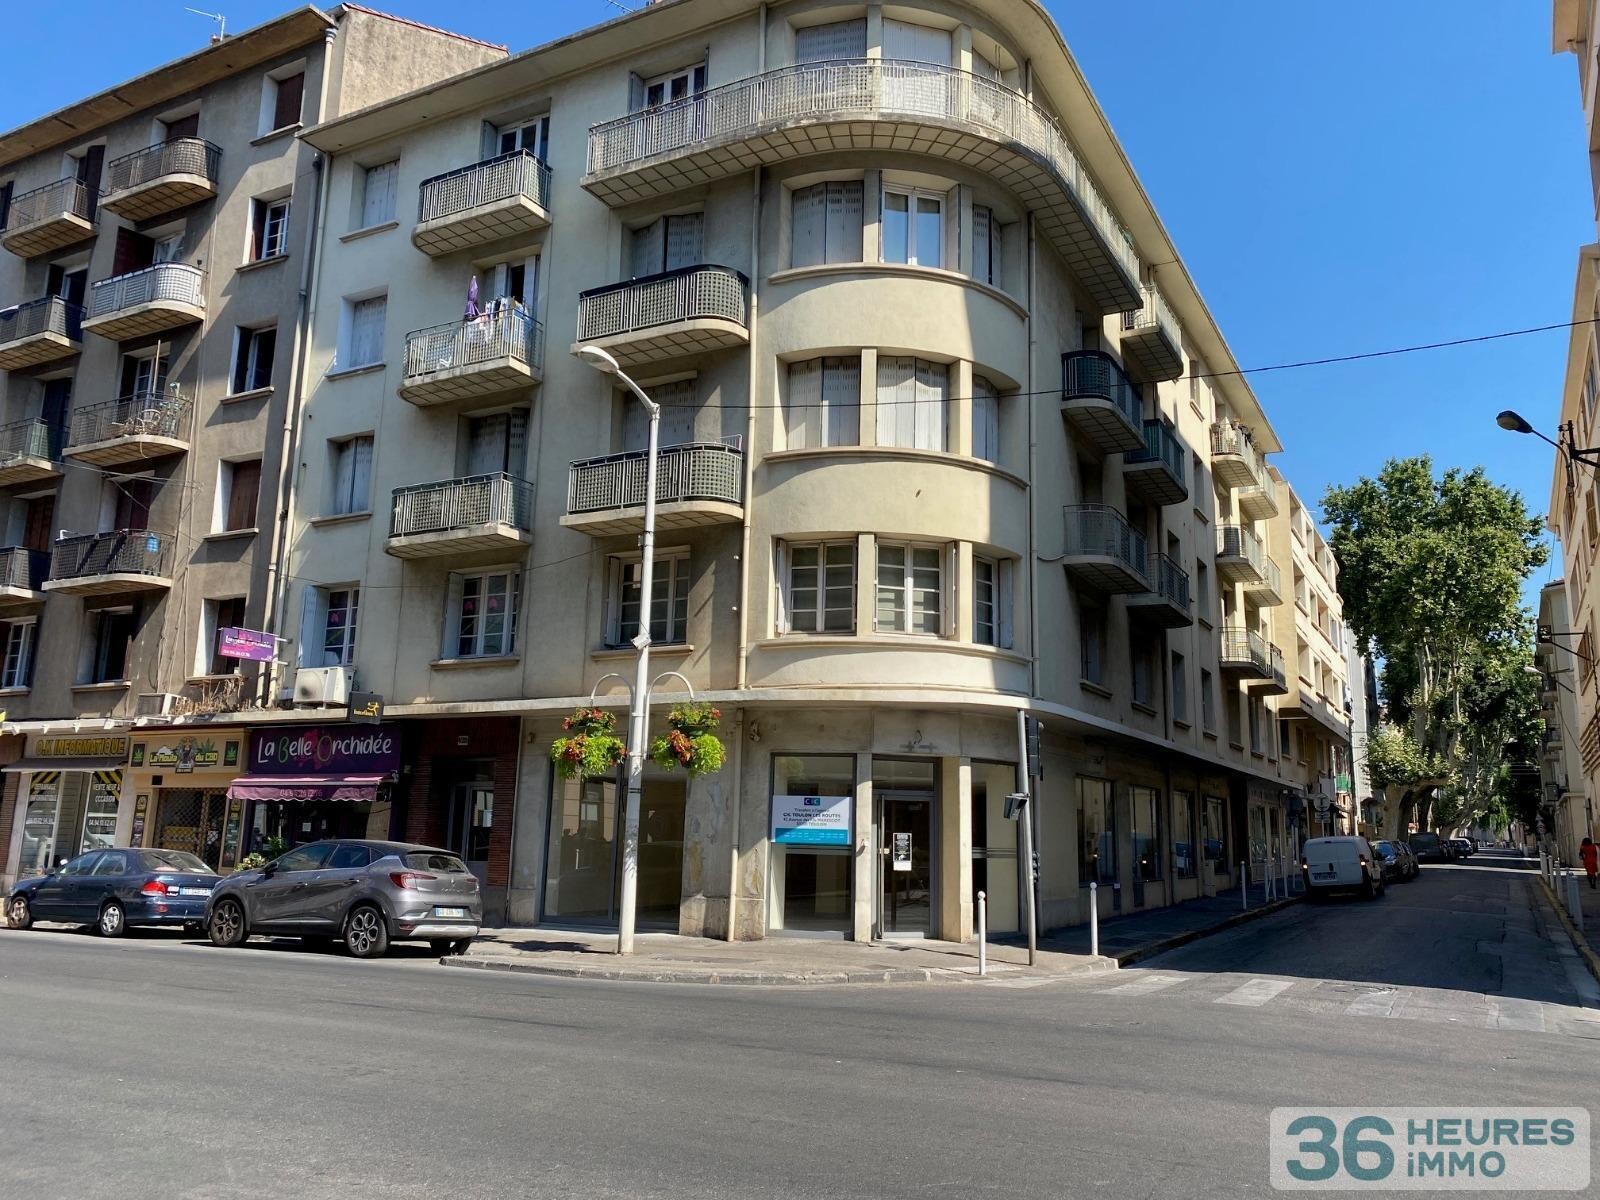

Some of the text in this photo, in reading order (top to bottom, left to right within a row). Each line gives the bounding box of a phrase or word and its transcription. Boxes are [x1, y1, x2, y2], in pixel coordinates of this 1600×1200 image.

[55, 738, 126, 755] INFORMATIQUE
[258, 732, 392, 763] La Belle Orchidée
[149, 753, 159, 762] La
[195, 753, 204, 762] du
[205, 752, 218, 761] CBD
